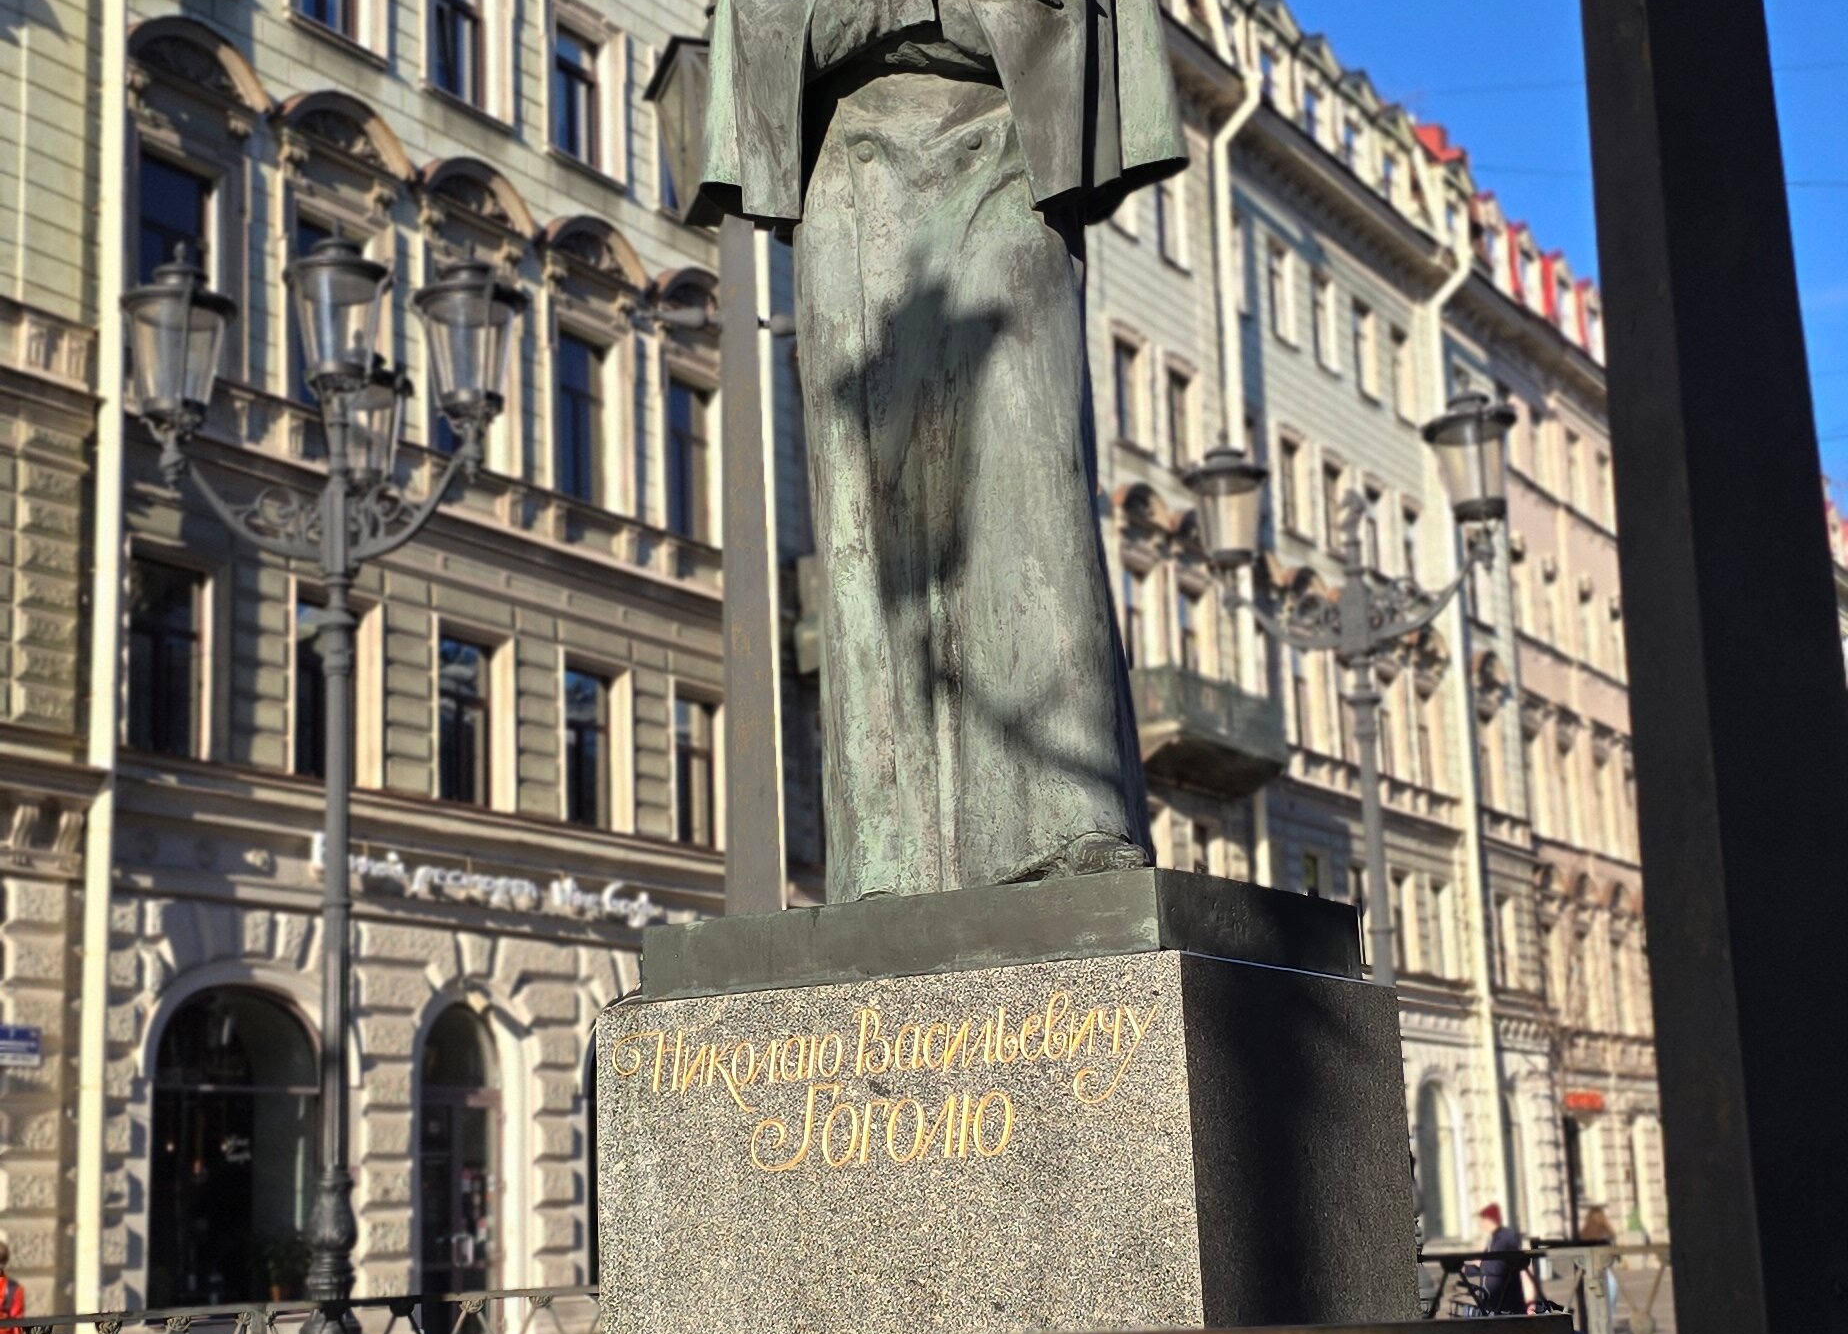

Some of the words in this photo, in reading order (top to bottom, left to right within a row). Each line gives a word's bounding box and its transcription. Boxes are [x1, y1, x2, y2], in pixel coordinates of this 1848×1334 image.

[611, 1028, 845, 1113] Николаю
[854, 991, 1159, 1105] Васильевичу
[749, 1082, 1014, 1172] Гоголю
